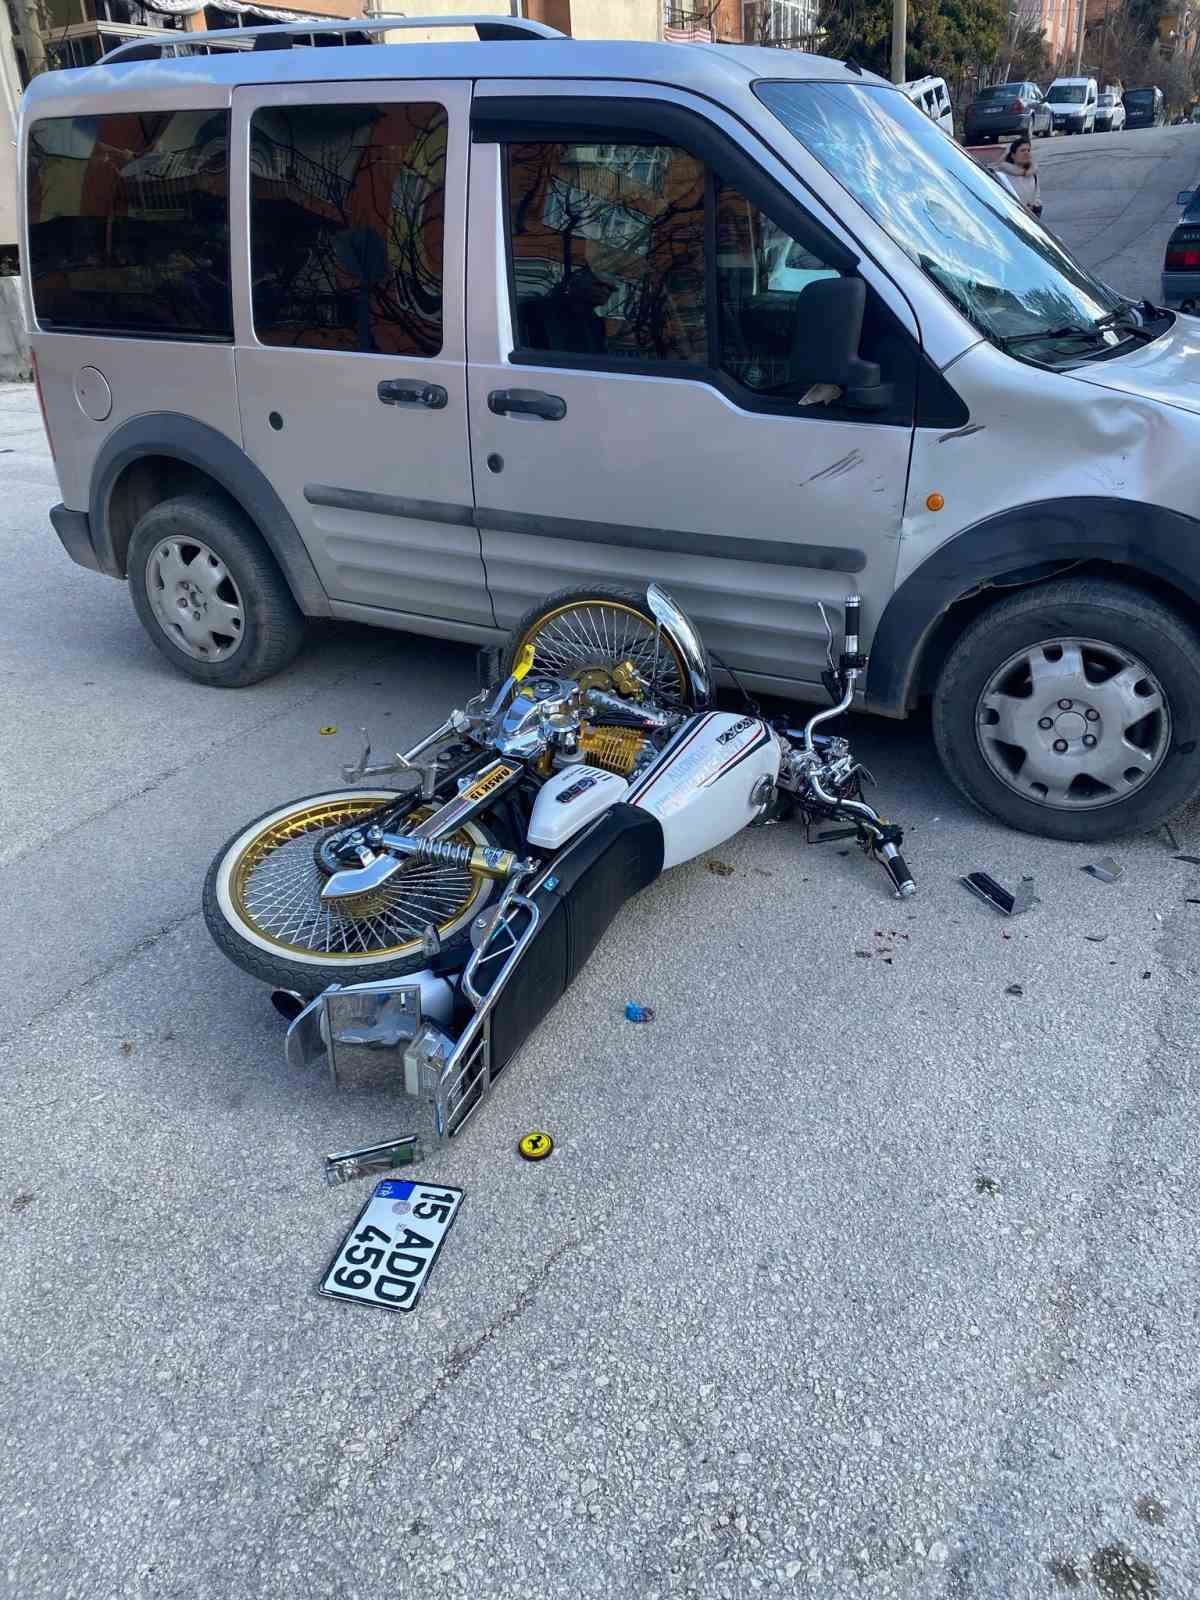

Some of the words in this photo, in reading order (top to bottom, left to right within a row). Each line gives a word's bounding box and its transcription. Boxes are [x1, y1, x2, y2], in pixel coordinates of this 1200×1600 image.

[412, 1192, 456, 1224] 15
[333, 1225, 392, 1290] 459
[374, 1228, 435, 1303] ADD
